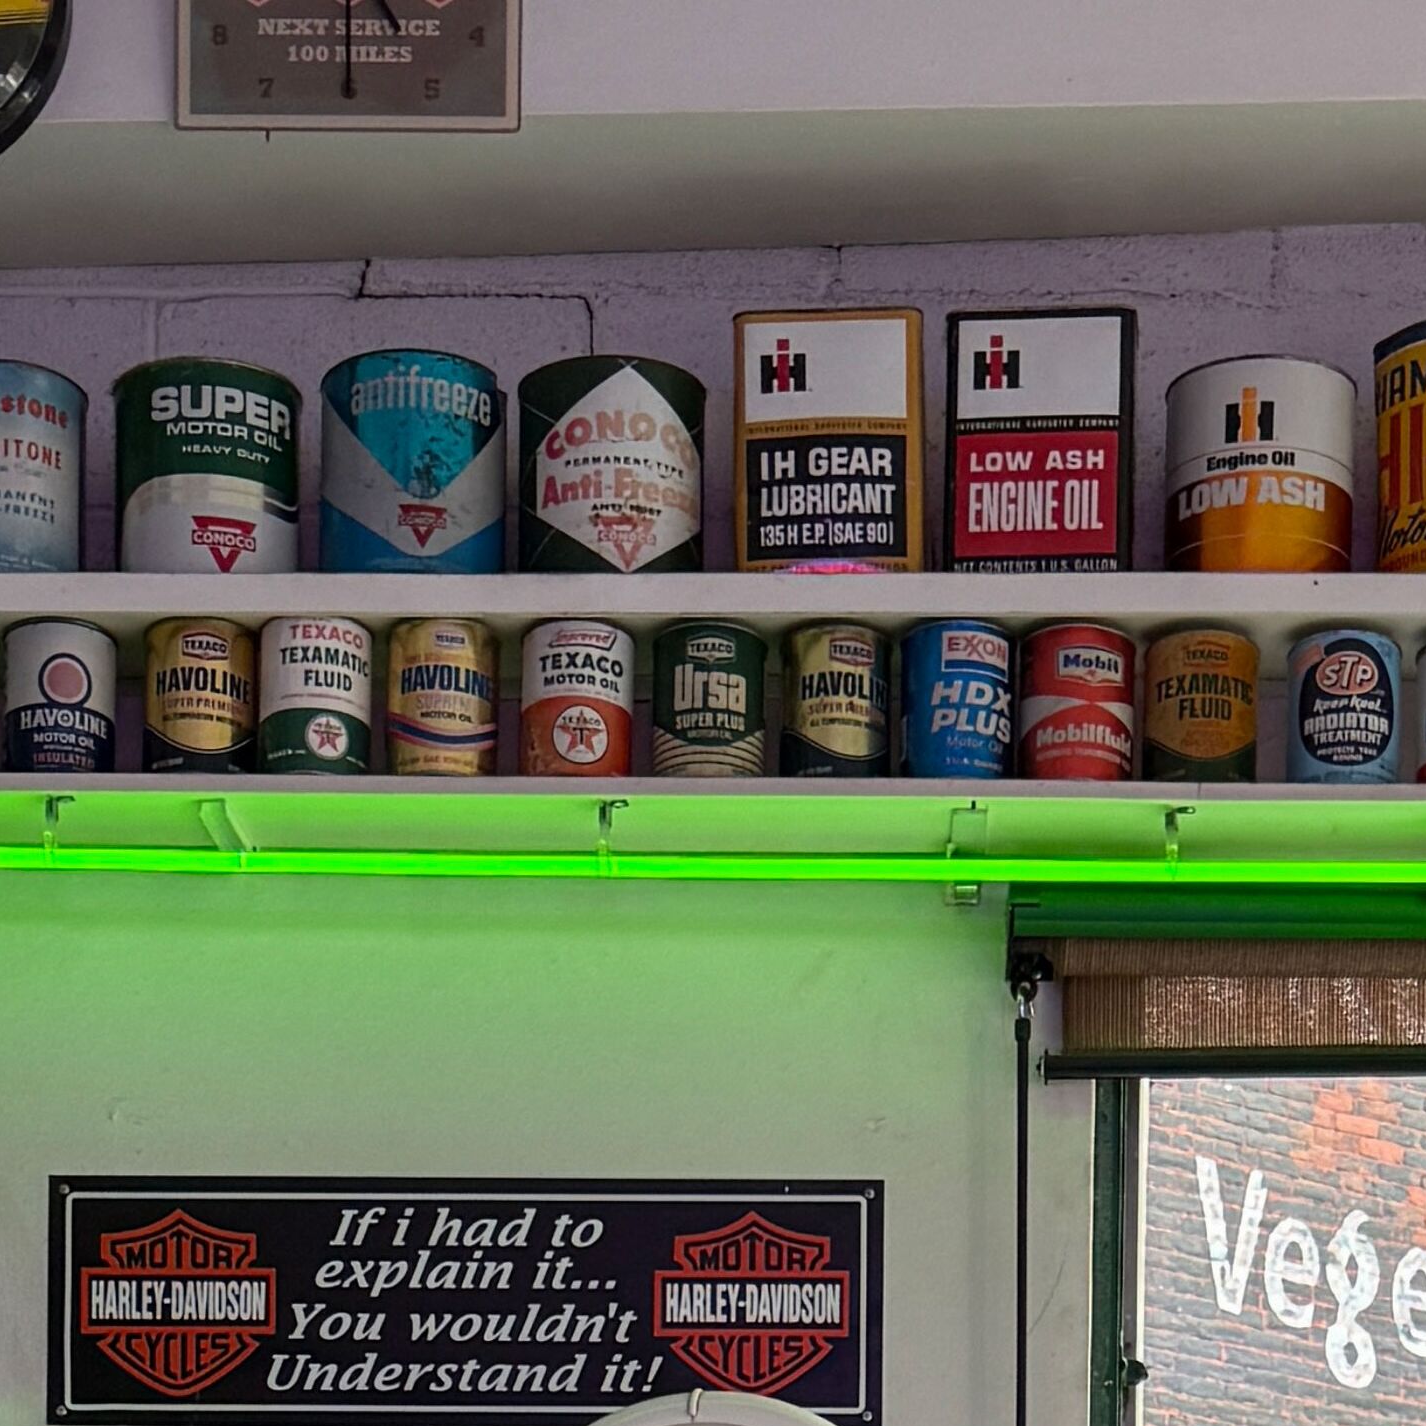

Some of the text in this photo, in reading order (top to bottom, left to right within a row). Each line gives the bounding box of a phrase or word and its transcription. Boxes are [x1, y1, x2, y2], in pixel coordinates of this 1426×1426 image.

[258, 17, 440, 38] NEXT SERVICE
[287, 44, 412, 64] 100 MILES
[350, 363, 492, 428] antifreeze
[150, 385, 292, 441] SUPER
[166, 422, 283, 452] MOTOR OIL
[182, 443, 271, 464] HEAVY DUTY
[760, 447, 893, 481] IH GEAR
[969, 450, 1105, 474] LOW ASH
[1206, 450, 1296, 474] Engine Oil
[760, 484, 896, 518] LUBRICANT
[968, 478, 1104, 533] ENGINE OIL
[1177, 476, 1326, 523] LOW ASH
[192, 530, 256, 552] CONOCO
[598, 530, 656, 545] CONOCO
[184, 637, 228, 655] TEXACO
[289, 623, 364, 650] TEXACO
[688, 641, 735, 655] TEXACO
[831, 643, 874, 660] TEXACO
[280, 646, 370, 678] TEXAMATIC
[539, 651, 624, 679] TEXACO
[1062, 652, 1121, 675] Mobil
[1185, 648, 1229, 663] TEXACO
[155, 666, 251, 705] HAVOLINE
[303, 669, 353, 692] FLUID
[400, 664, 494, 701] HAVOLINE
[543, 673, 621, 694] MOTOR OIL
[1321, 656, 1374, 690] STP
[674, 663, 748, 715] Ursa
[931, 680, 1012, 716] HDX
[1155, 673, 1254, 704] TEXAMATIC
[19, 709, 108, 740] HAVOLINE
[675, 711, 747, 732] SUPER PLUS
[1178, 697, 1232, 722] FLUID
[1304, 712, 1390, 737] RADIATOR
[931, 707, 1012, 744] PLUS
[1313, 732, 1383, 747] TREATMENT
[33, 732, 96, 750] MOTOR OIL
[329, 1207, 607, 1249] If i had to
[314, 1250, 621, 1299] explain it...
[89, 1279, 267, 1323] HARLEY-DAVIDSON
[664, 1283, 842, 1326] HARLEY-DAVIDSON
[287, 1302, 640, 1346] You wouldn't
[264, 1352, 664, 1395] Understand it!
